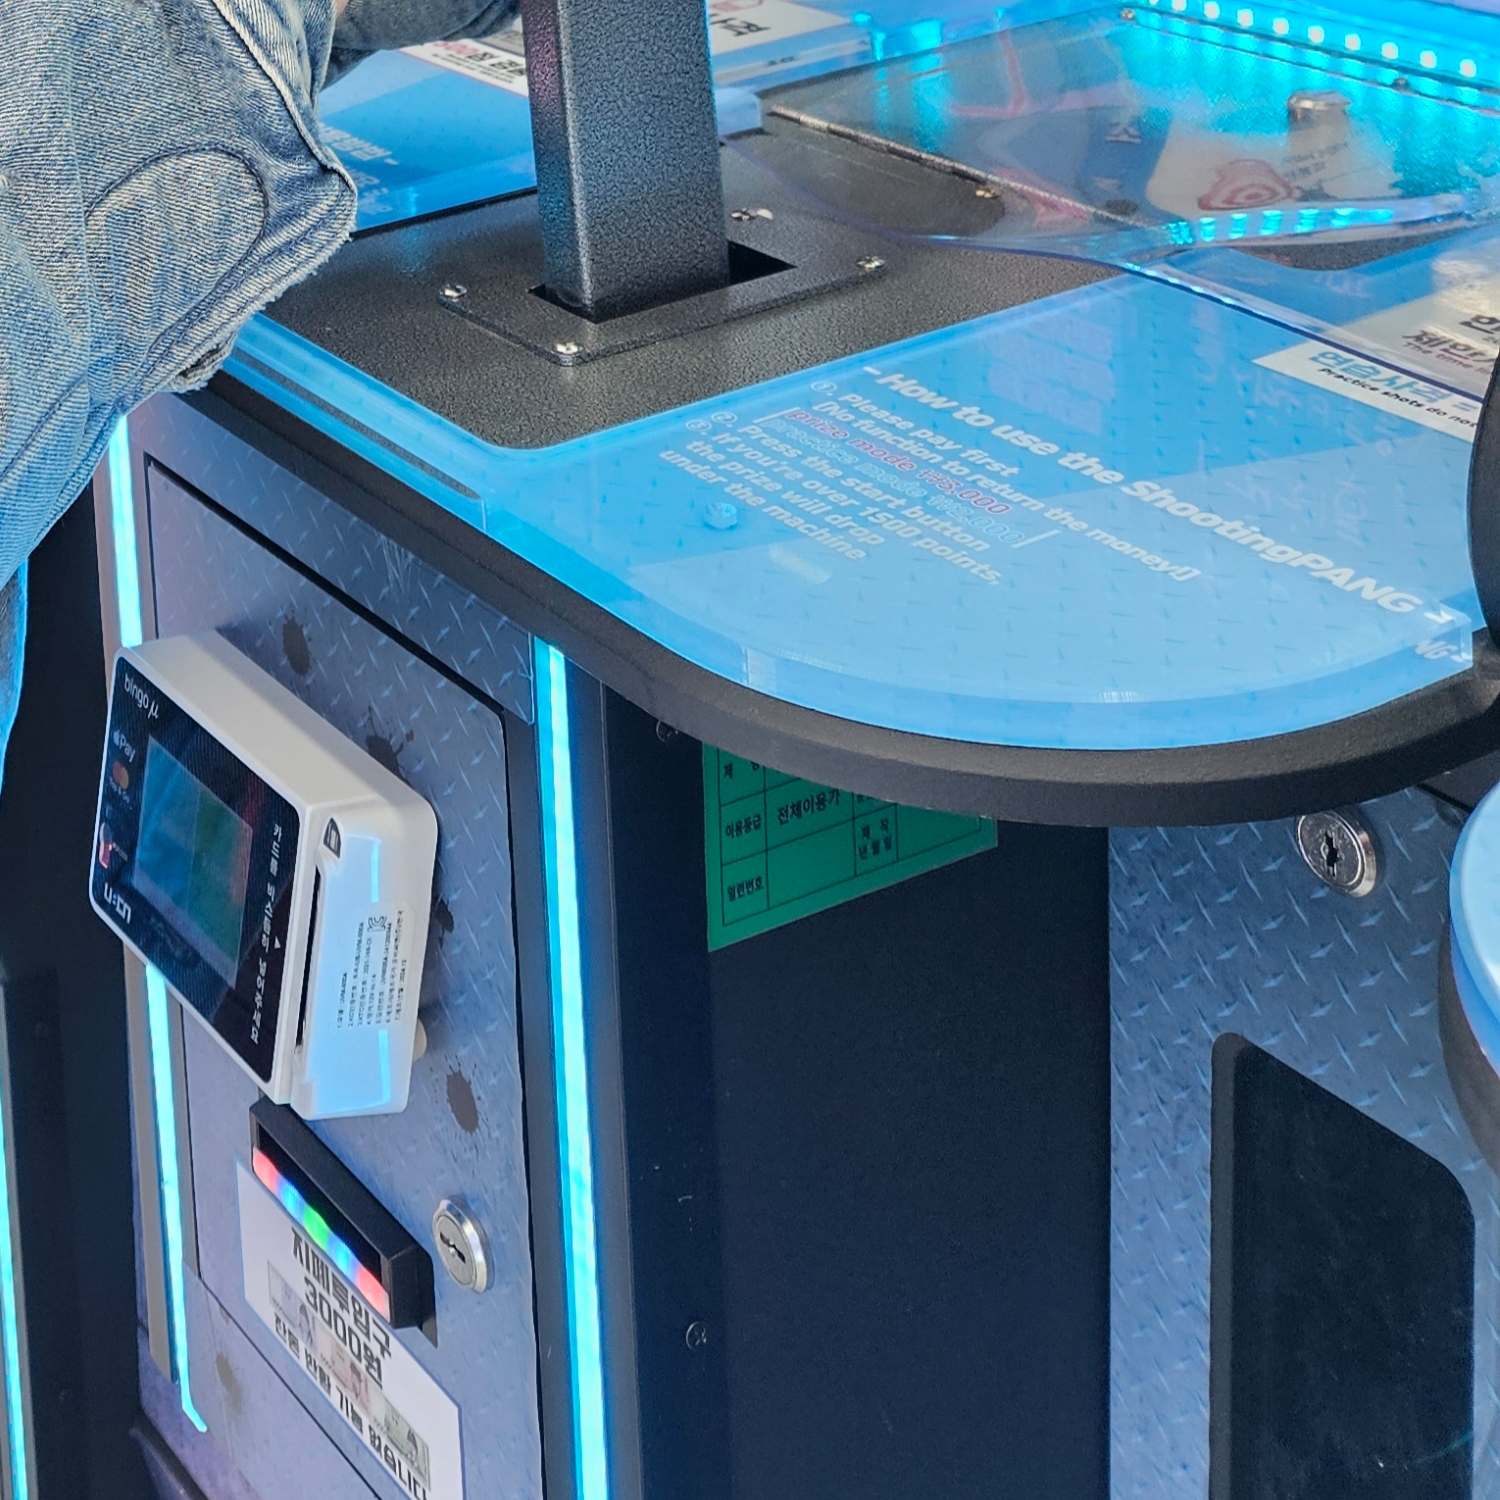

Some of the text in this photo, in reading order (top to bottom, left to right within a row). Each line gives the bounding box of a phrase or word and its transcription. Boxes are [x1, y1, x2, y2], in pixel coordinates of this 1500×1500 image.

[1309, 351, 1455, 405] 연습사격
[1381, 388, 1424, 408] shots
[1426, 405, 1448, 418] do
[711, 432, 742, 445] If
[725, 443, 805, 481] you're
[760, 418, 860, 465] practice
[854, 462, 928, 499] mode
[785, 410, 851, 441] prize
[848, 438, 917, 472] mode
[838, 393, 916, 430] Please
[908, 427, 964, 451] pay
[959, 449, 1021, 478] first
[657, 449, 868, 561] under the machine
[685, 440, 886, 546] the prize will drop
[736, 424, 803, 459] Press
[800, 455, 844, 479] the
[840, 476, 907, 510] start
[899, 505, 991, 552] button
[801, 479, 862, 507] over
[851, 418, 945, 464] function
[940, 459, 972, 477] to
[964, 473, 1046, 513] return
[1042, 506, 1090, 533] the
[875, 373, 1425, 614] How to use the ShootingPANG
[858, 505, 922, 539] 1500
[124, 672, 149, 709] bingo
[725, 788, 841, 839] 이용등급 전체이용가
[726, 875, 764, 903] 일련번호
[291, 1225, 393, 1359] 지폐투입구
[303, 1275, 384, 1391] 3000원
[273, 1311, 301, 1361] 잔돈
[336, 1385, 364, 1433] 기능
